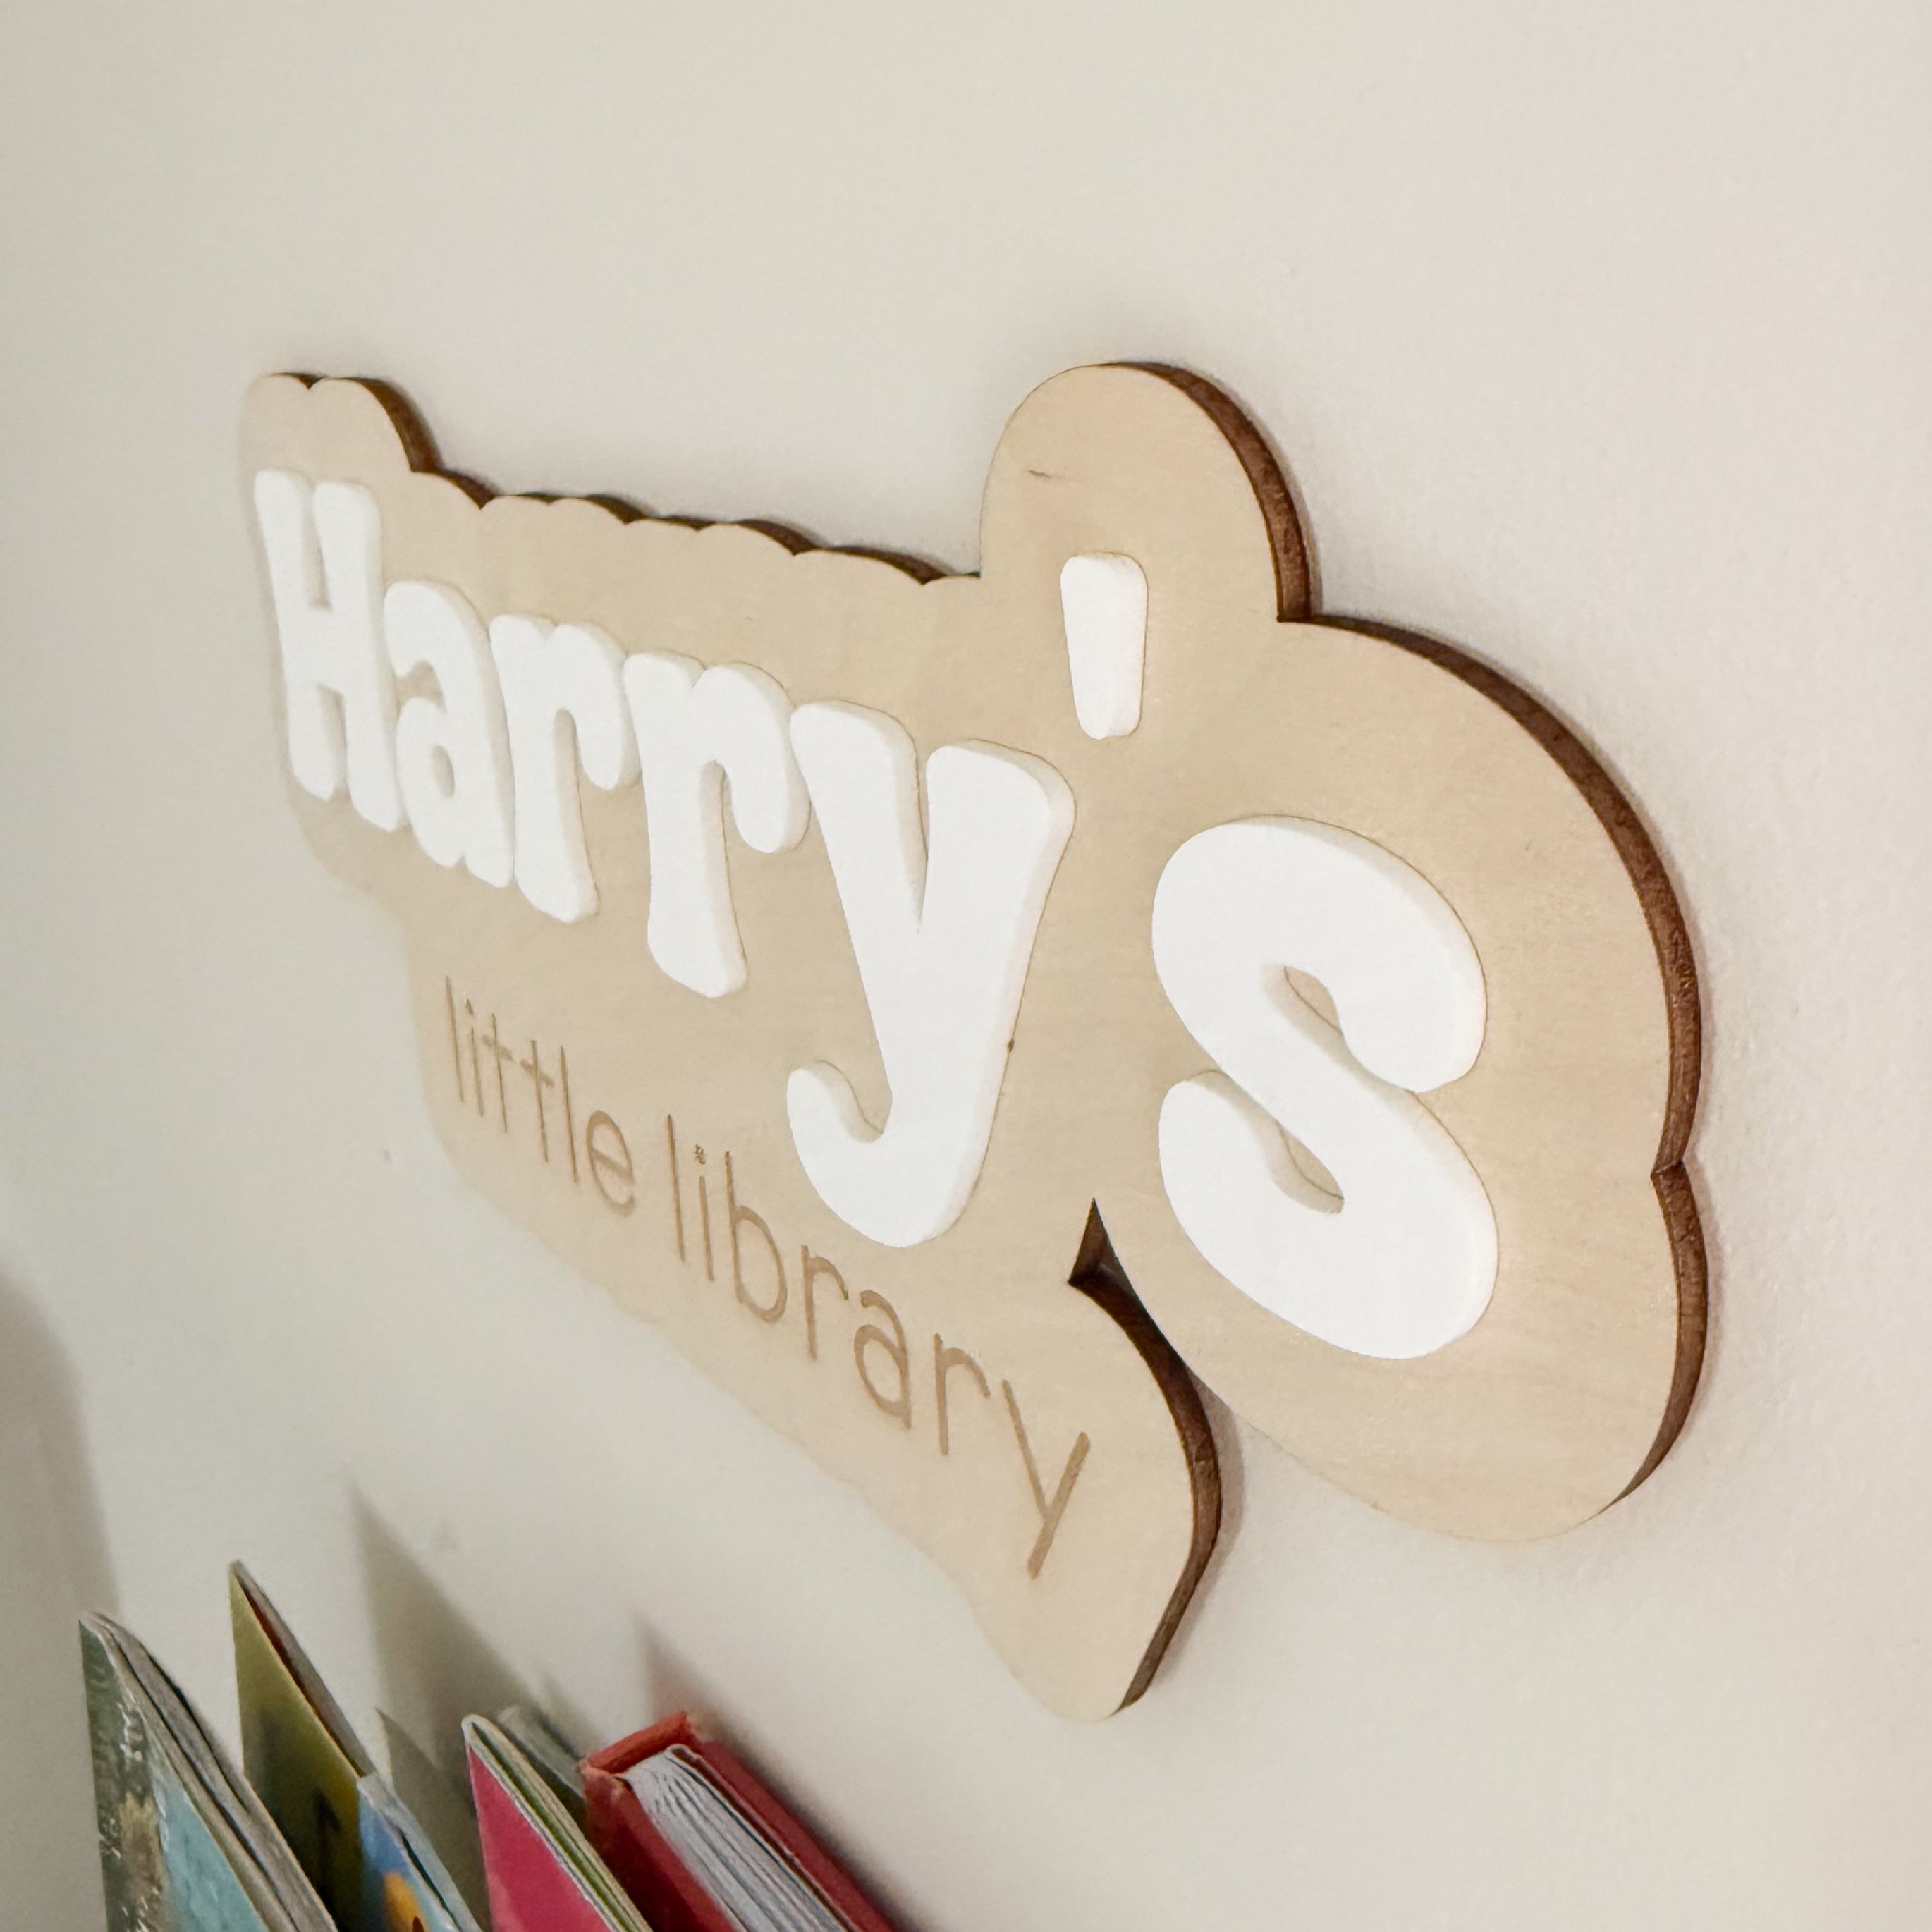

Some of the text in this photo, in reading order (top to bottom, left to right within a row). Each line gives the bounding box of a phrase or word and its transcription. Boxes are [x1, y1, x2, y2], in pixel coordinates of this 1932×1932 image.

[254, 470, 1498, 1359] Harry's
[446, 975, 1091, 1580] little library
